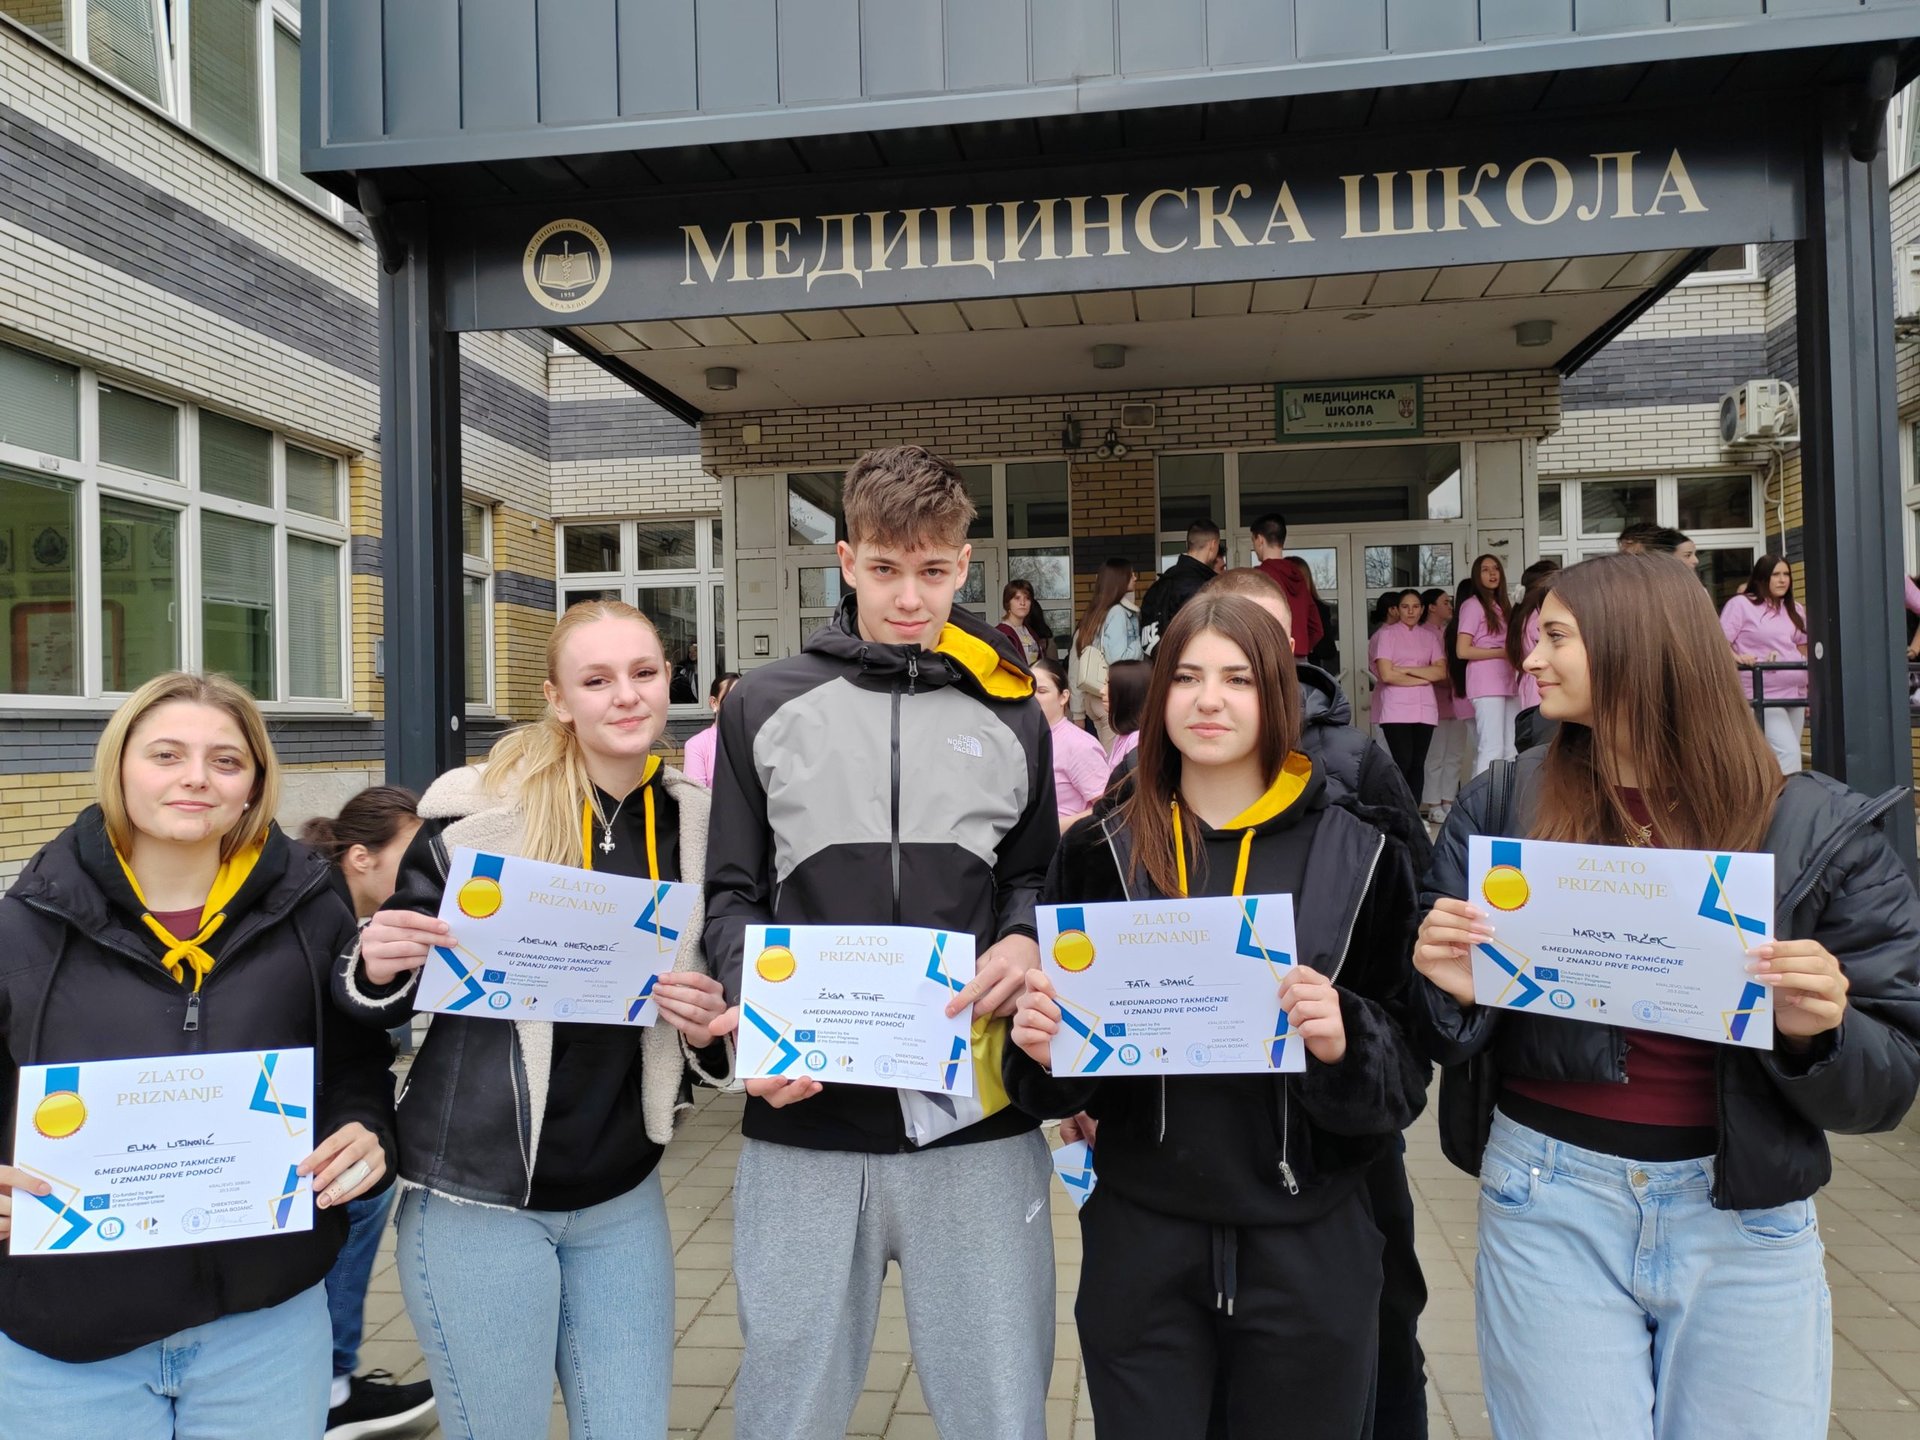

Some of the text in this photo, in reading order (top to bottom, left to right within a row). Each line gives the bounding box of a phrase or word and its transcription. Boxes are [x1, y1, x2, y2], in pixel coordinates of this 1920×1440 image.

[680, 148, 1709, 292] МЕДИЦИНСКА ШКОЛА
[1303, 389, 1396, 404] МЕДИЦИНСКА
[1325, 405, 1374, 417] ШКОЛА
[947, 737, 972, 748] NORTH
[958, 734, 972, 743] THE
[953, 746, 972, 755] FACE
[1578, 858, 1646, 874] ZLATO
[549, 876, 606, 895] ZLATO
[1557, 876, 1668, 900] PRIZNANJE
[528, 891, 618, 915] PRIZNANJE
[1133, 912, 1191, 926] ZLATO
[518, 936, 557, 947] ADELINA
[836, 936, 888, 946] ZLATO
[1118, 929, 1210, 945] PRIZNANJE
[516, 961, 547, 970] ZNANJU
[567, 957, 612, 966] TAKMIČENJE
[820, 951, 904, 966] PRIZNANJE
[1566, 957, 1602, 967] ZNANJU
[1604, 961, 1629, 970] PRVE
[1631, 964, 1670, 974] POMOĆI
[1625, 954, 1684, 966] TAKMIČENJE
[1125, 975, 1194, 988] FATA SPAHIĆ
[1180, 995, 1229, 1004] TAKMIČENJE
[871, 1011, 916, 1020] TAKMIČENJE
[875, 1020, 905, 1028] POMOĆI
[138, 1068, 204, 1084] ZLATO
[116, 1086, 224, 1106] PRIZNANJE
[94, 1155, 236, 1176] 6.MEĐUNARODNO TAKMIČENJE
[119, 1174, 158, 1184] ZNANJU
[159, 1171, 184, 1180] PRVE
[186, 1166, 223, 1176] POMOĆI
